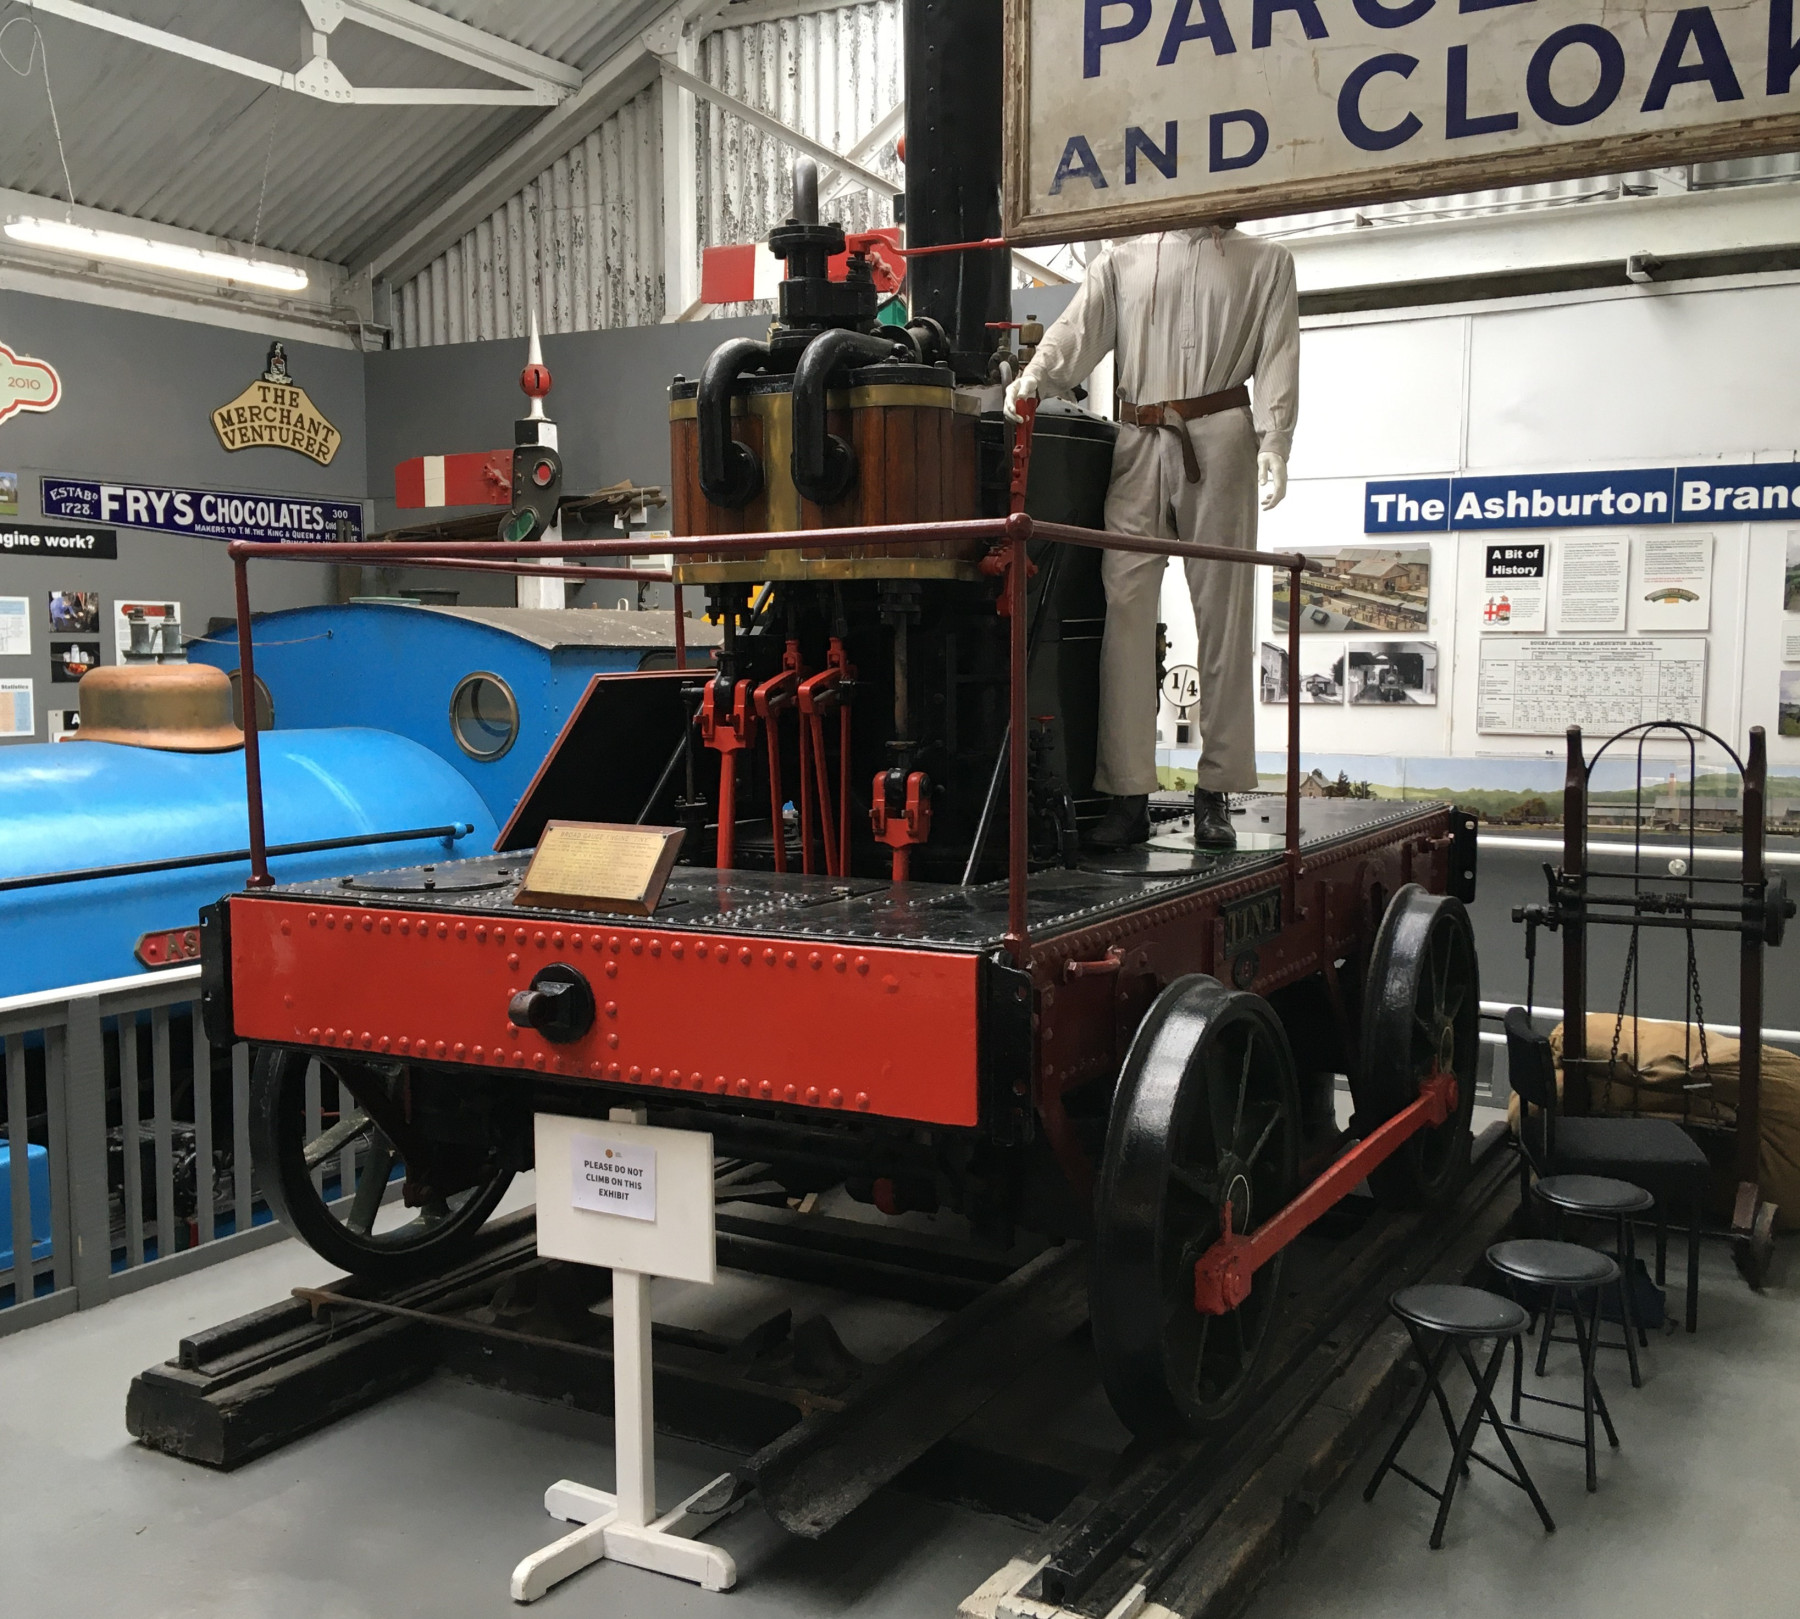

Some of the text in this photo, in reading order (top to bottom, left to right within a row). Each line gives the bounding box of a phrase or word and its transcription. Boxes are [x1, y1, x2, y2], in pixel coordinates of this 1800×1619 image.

[1048, 108, 1269, 196] AND
[8, 376, 41, 390] 2010
[258, 386, 300, 408] THE
[218, 405, 335, 443] MERCHANT
[223, 424, 331, 461] VENTURER
[100, 485, 324, 531] FRY'S CHOCOLATES
[1370, 493, 1445, 523] The
[1454, 486, 1668, 520] Ashburton
[332, 509, 349, 519] 300
[194, 523, 226, 534] MAKERS
[227, 526, 236, 535] TO
[267, 528, 284, 538] KING
[292, 531, 314, 540] QUEEN
[45, 535, 95, 549] work?
[1492, 549, 1539, 560] A Bit of
[1492, 565, 1538, 577] History
[584, 1160, 643, 1178] PLEASE DO NOT
[586, 1173, 642, 1190] CLIMB ON THIS
[599, 1188, 629, 1200] EXHIBIT
